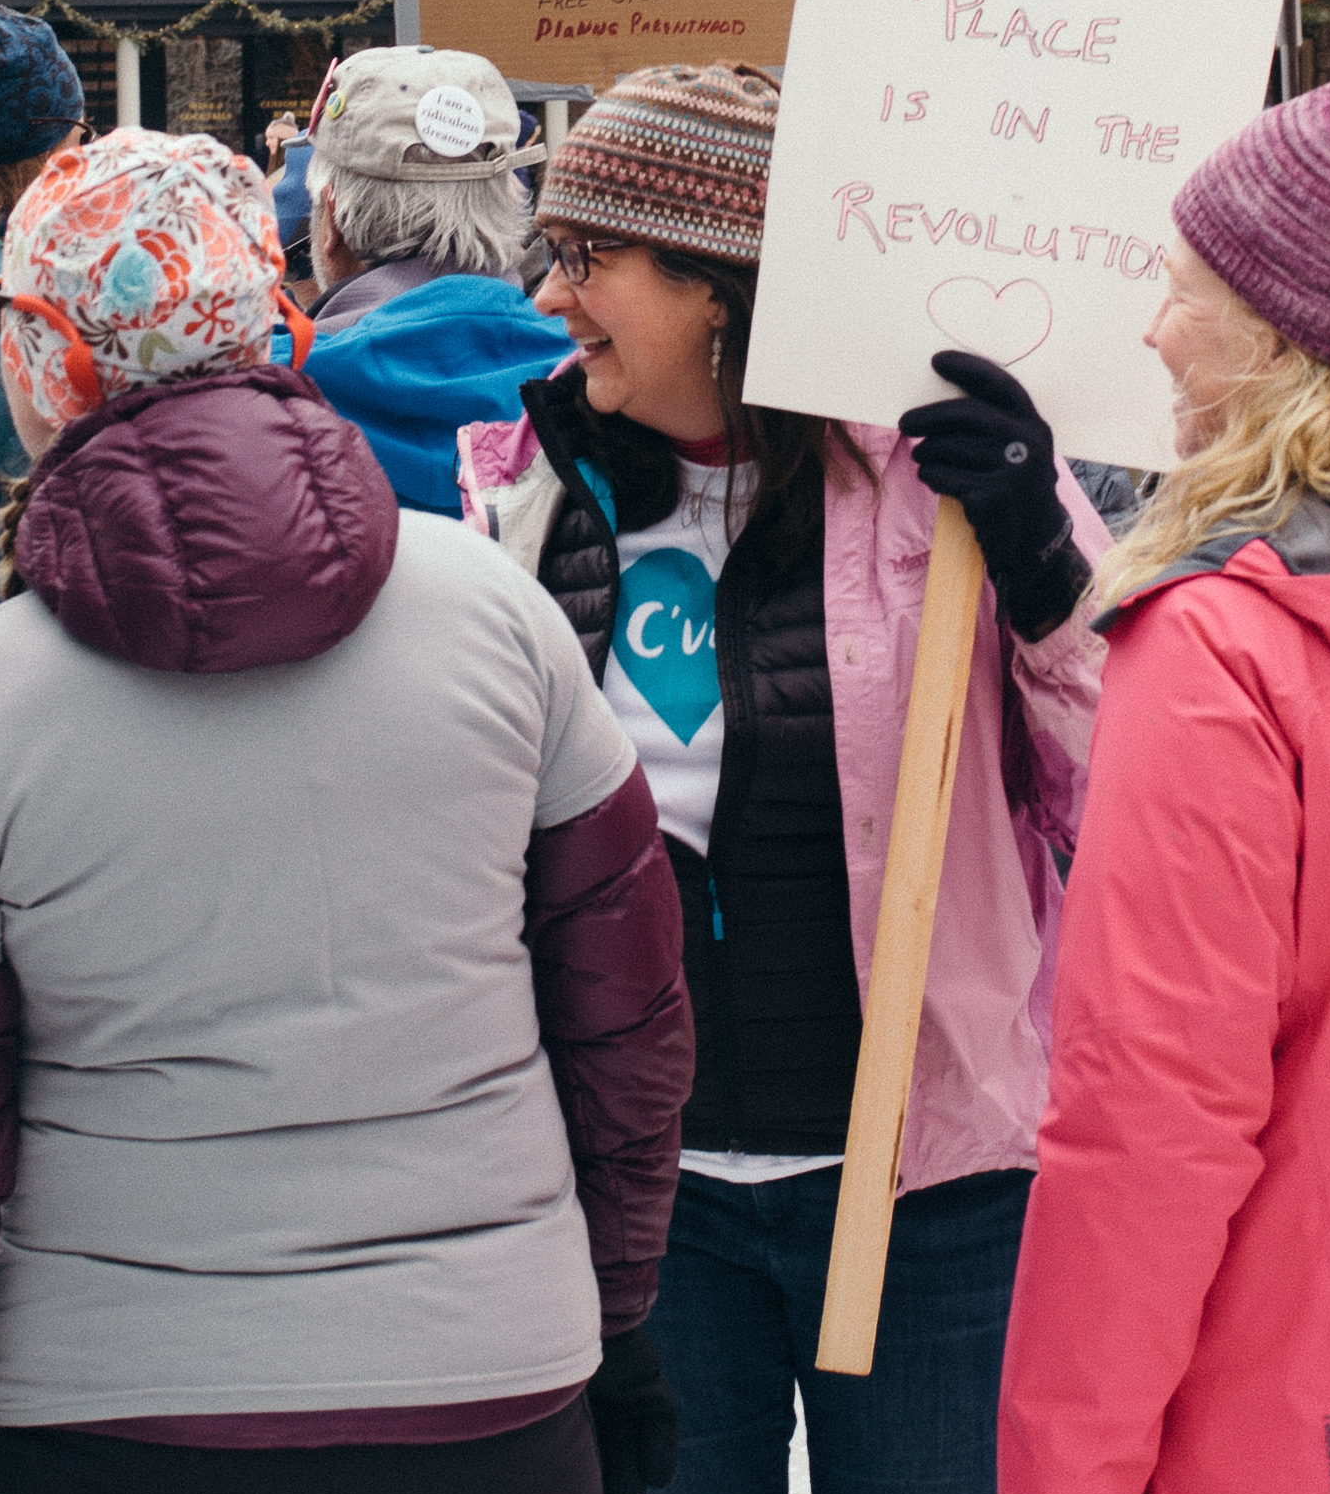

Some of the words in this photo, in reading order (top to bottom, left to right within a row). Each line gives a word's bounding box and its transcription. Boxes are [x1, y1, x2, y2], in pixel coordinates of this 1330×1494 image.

[445, 99, 462, 110] am
[421, 109, 479, 134] ridiculous
[880, 83, 930, 124] IS
[990, 99, 1050, 144] IN
[1095, 113, 1180, 164] THE
[422, 125, 470, 148] dreamer
